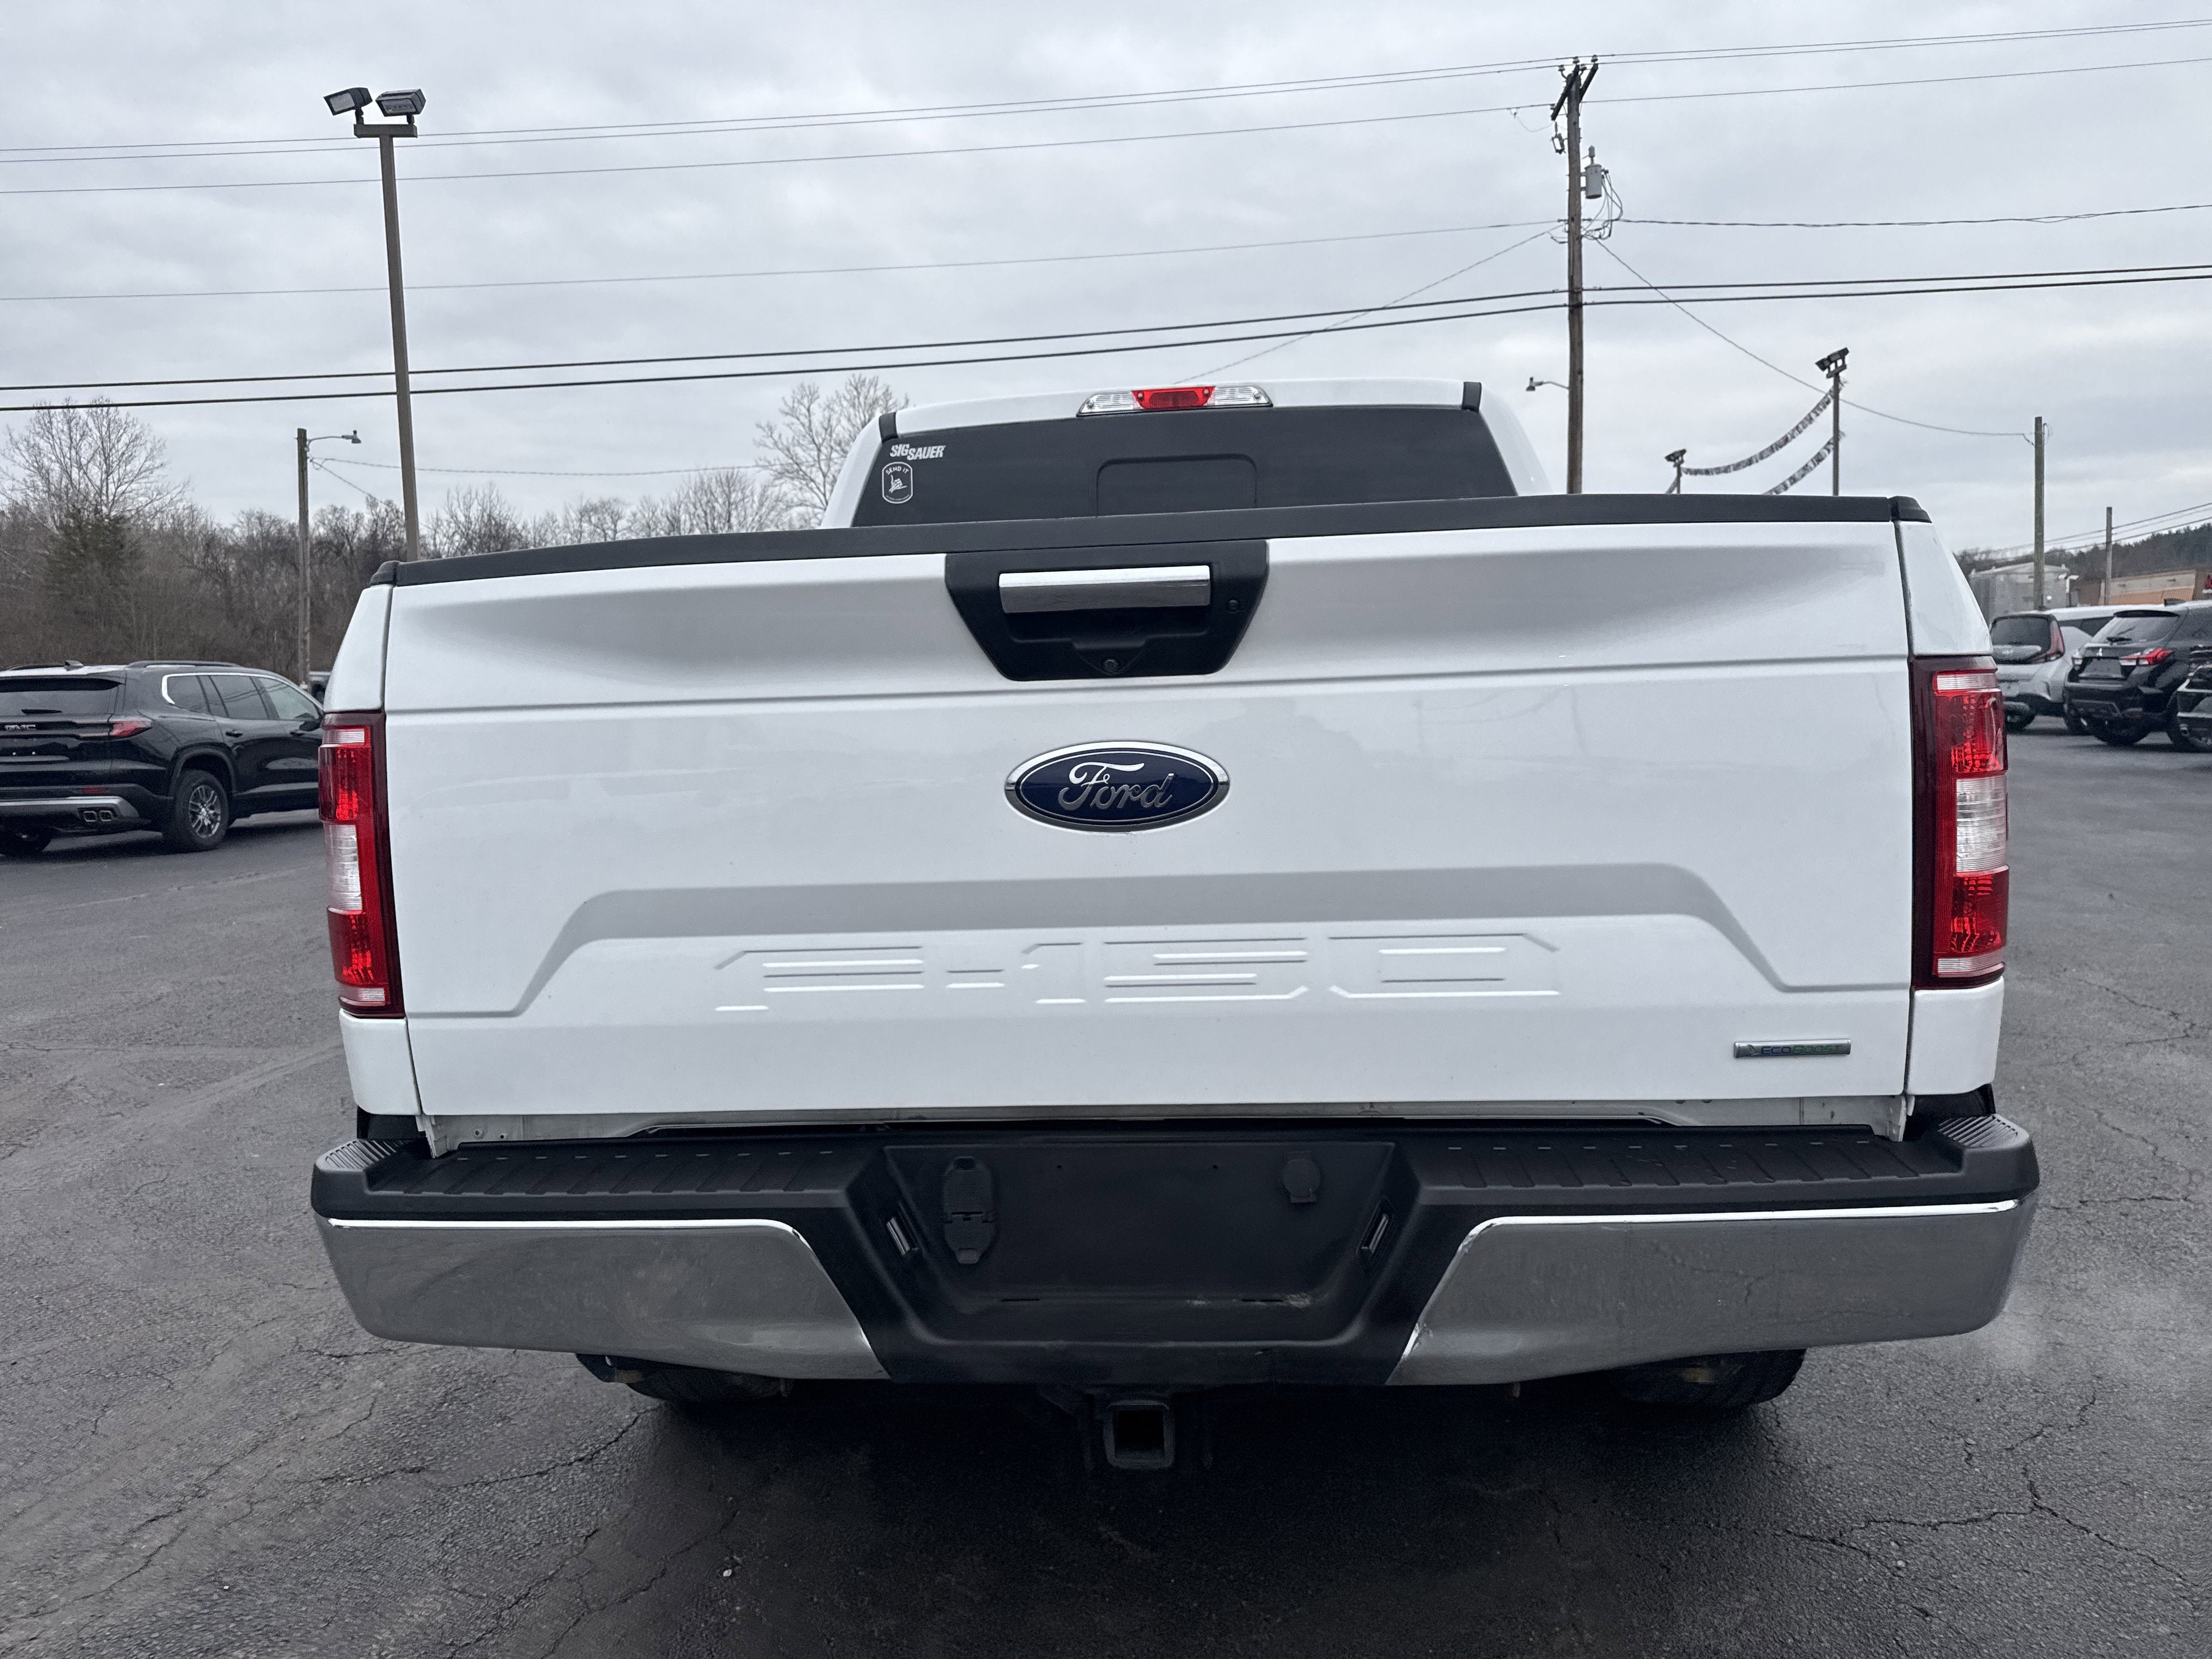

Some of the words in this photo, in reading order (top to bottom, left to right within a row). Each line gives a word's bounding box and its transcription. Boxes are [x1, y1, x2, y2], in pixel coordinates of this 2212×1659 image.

[890, 444, 910, 457] SIG
[907, 445, 945, 460] SAUER
[885, 466, 901, 475] SEND
[1058, 761, 1174, 810] Ford
[715, 933, 1560, 1012] F-150
